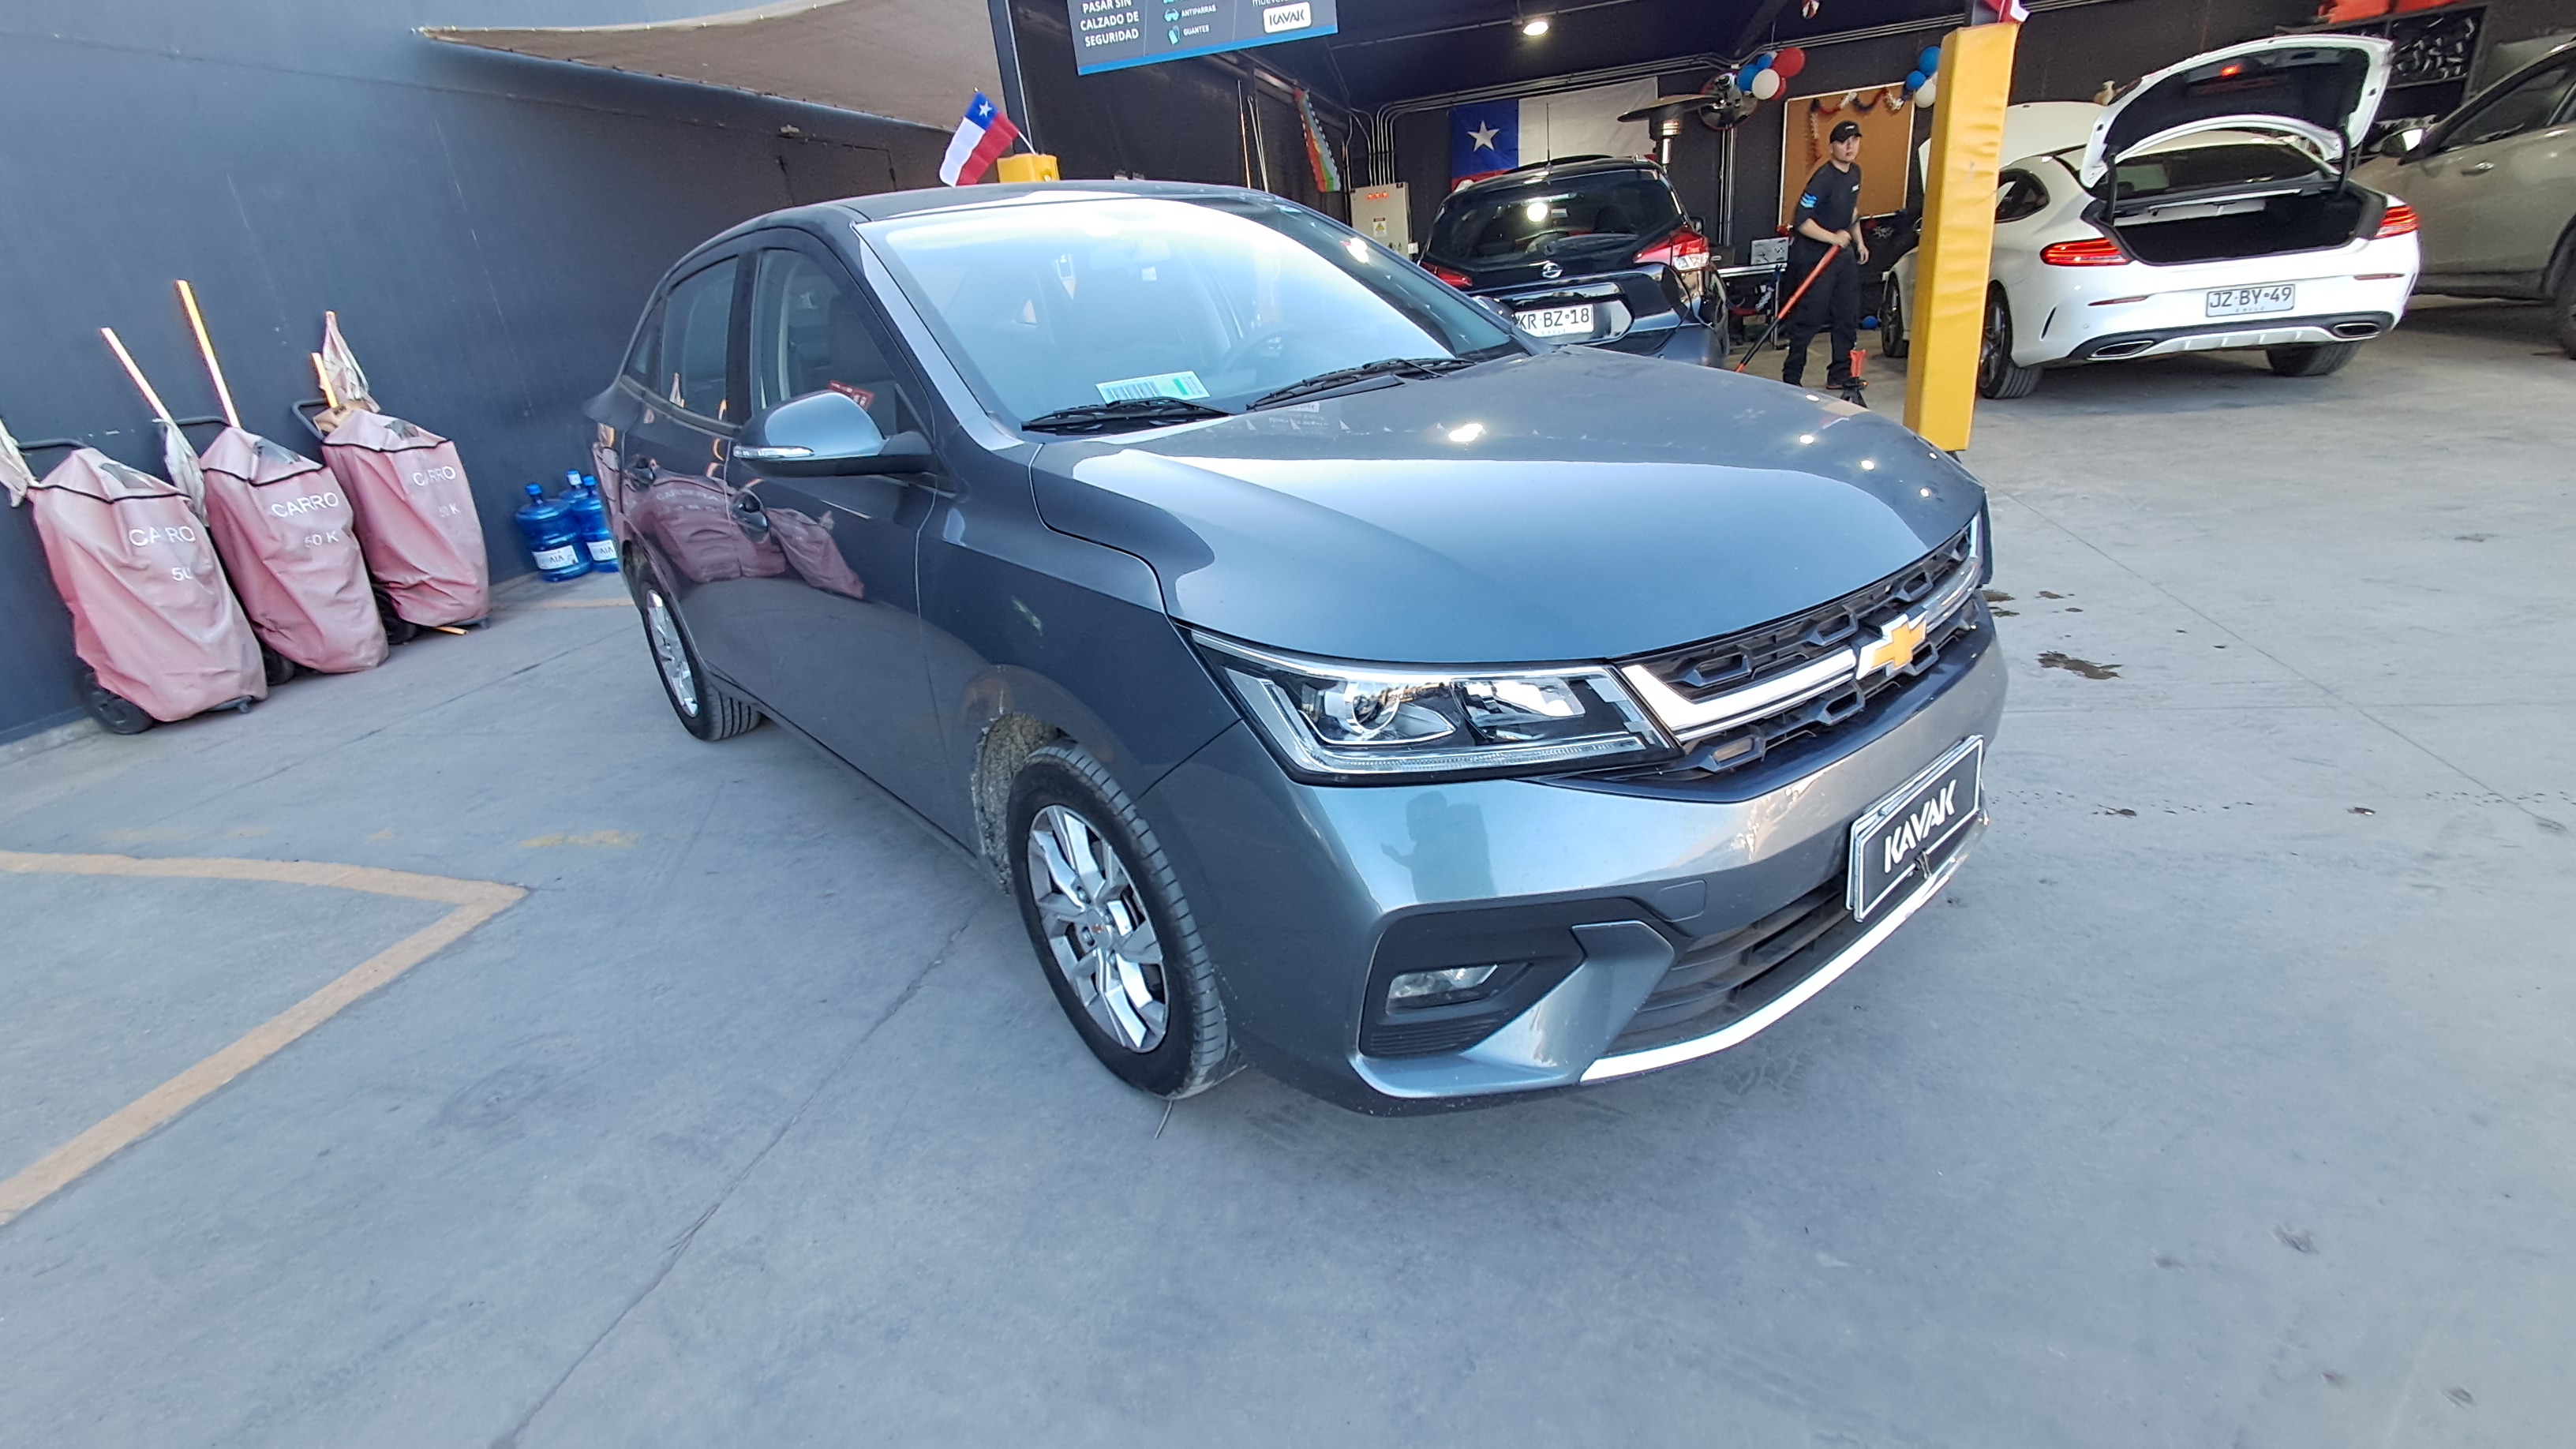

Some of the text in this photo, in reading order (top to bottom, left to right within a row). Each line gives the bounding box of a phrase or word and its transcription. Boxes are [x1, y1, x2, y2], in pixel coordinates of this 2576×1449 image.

[1082, 0, 1117, 14] PASAR
[1181, 4, 1217, 17] ANTIPARRAS
[1080, 11, 1140, 32] CALZADO DE
[1269, 9, 1305, 26] KAVAK
[1084, 28, 1140, 47] SEGURIDAD
[1183, 24, 1210, 36] GUANTES
[271, 492, 339, 518] CARRO
[449, 504, 460, 515] K
[326, 530, 339, 544] K
[1884, 778, 1957, 874] KAVAK
